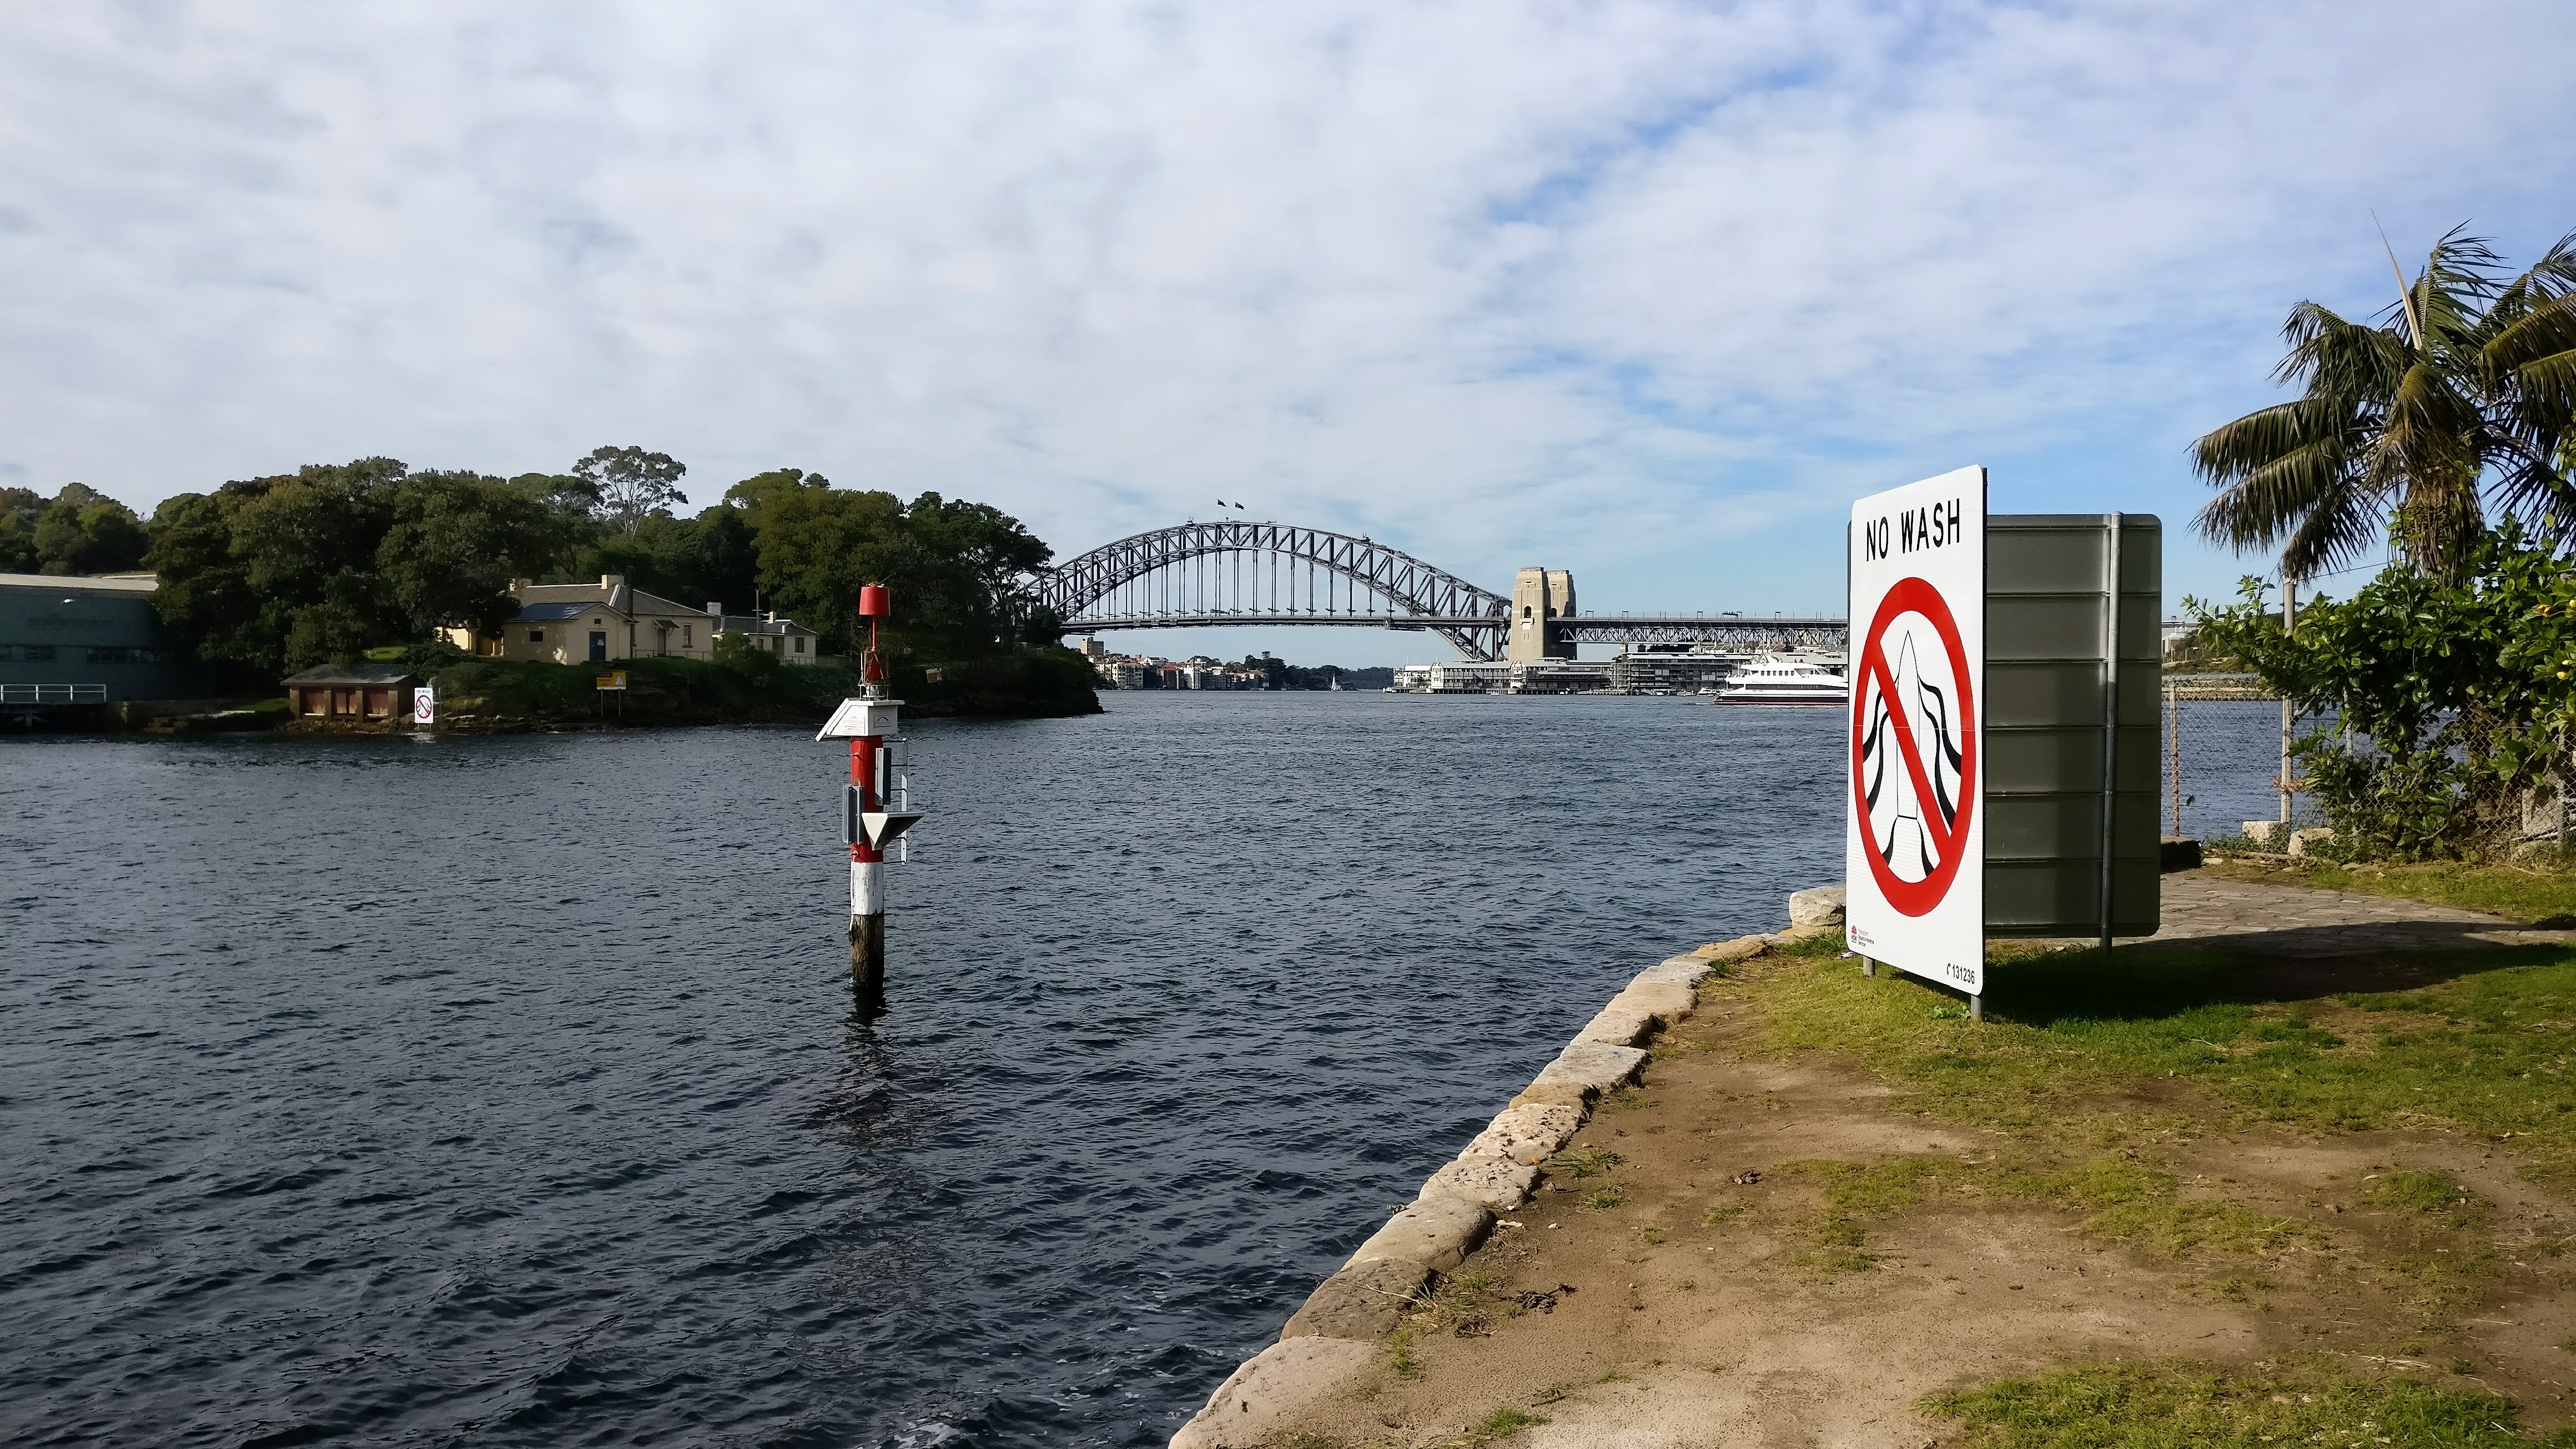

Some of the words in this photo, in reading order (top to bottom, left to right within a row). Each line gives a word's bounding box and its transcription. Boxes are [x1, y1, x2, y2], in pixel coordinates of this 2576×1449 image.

[1866, 516, 1889, 562] NO
[1901, 498, 1960, 554] WASH
[1952, 964, 1975, 984] 131236
